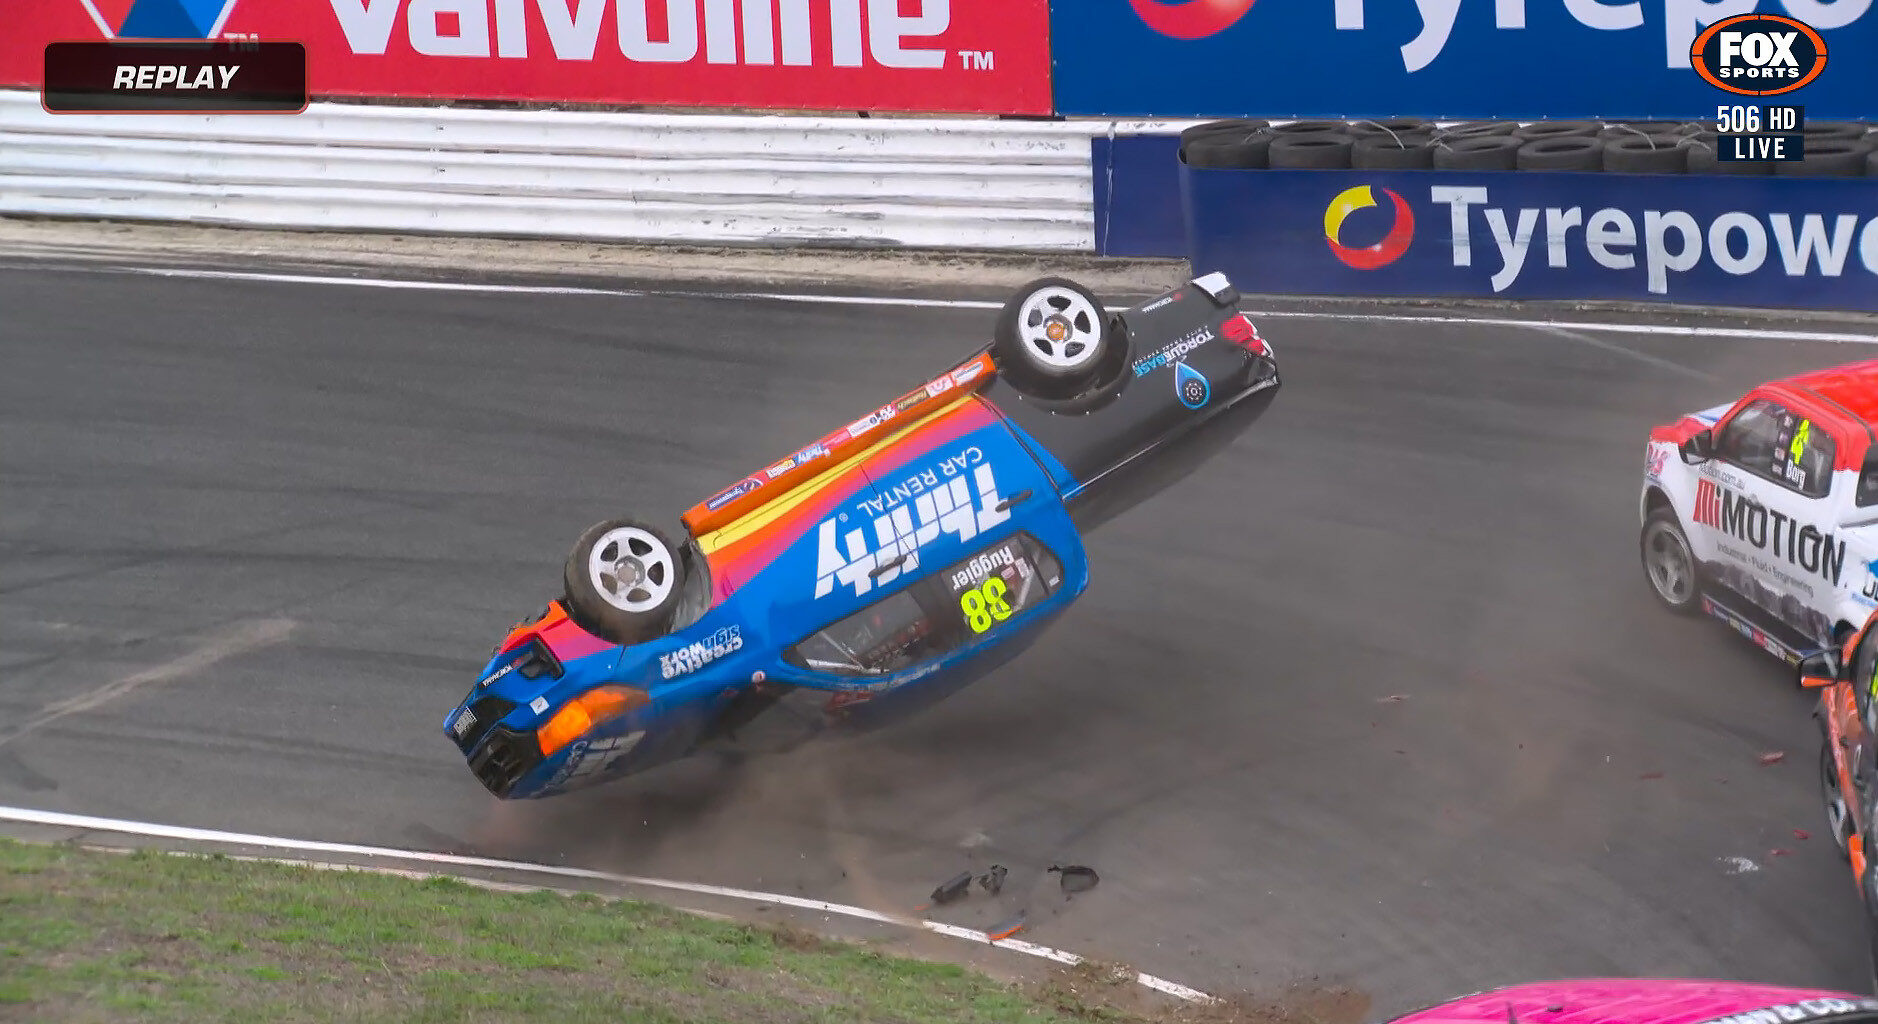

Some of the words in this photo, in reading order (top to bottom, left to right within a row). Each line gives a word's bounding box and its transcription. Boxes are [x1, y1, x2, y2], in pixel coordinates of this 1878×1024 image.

[958, 50, 995, 70] TM
[939, 446, 983, 476] CAR
[1786, 460, 1806, 490] Borg
[857, 468, 938, 517] RENTAL
[814, 462, 1011, 600] Thrifty
[952, 546, 1015, 591] Ruggier
[960, 576, 1012, 634] 38
[661, 637, 743, 679] creative
